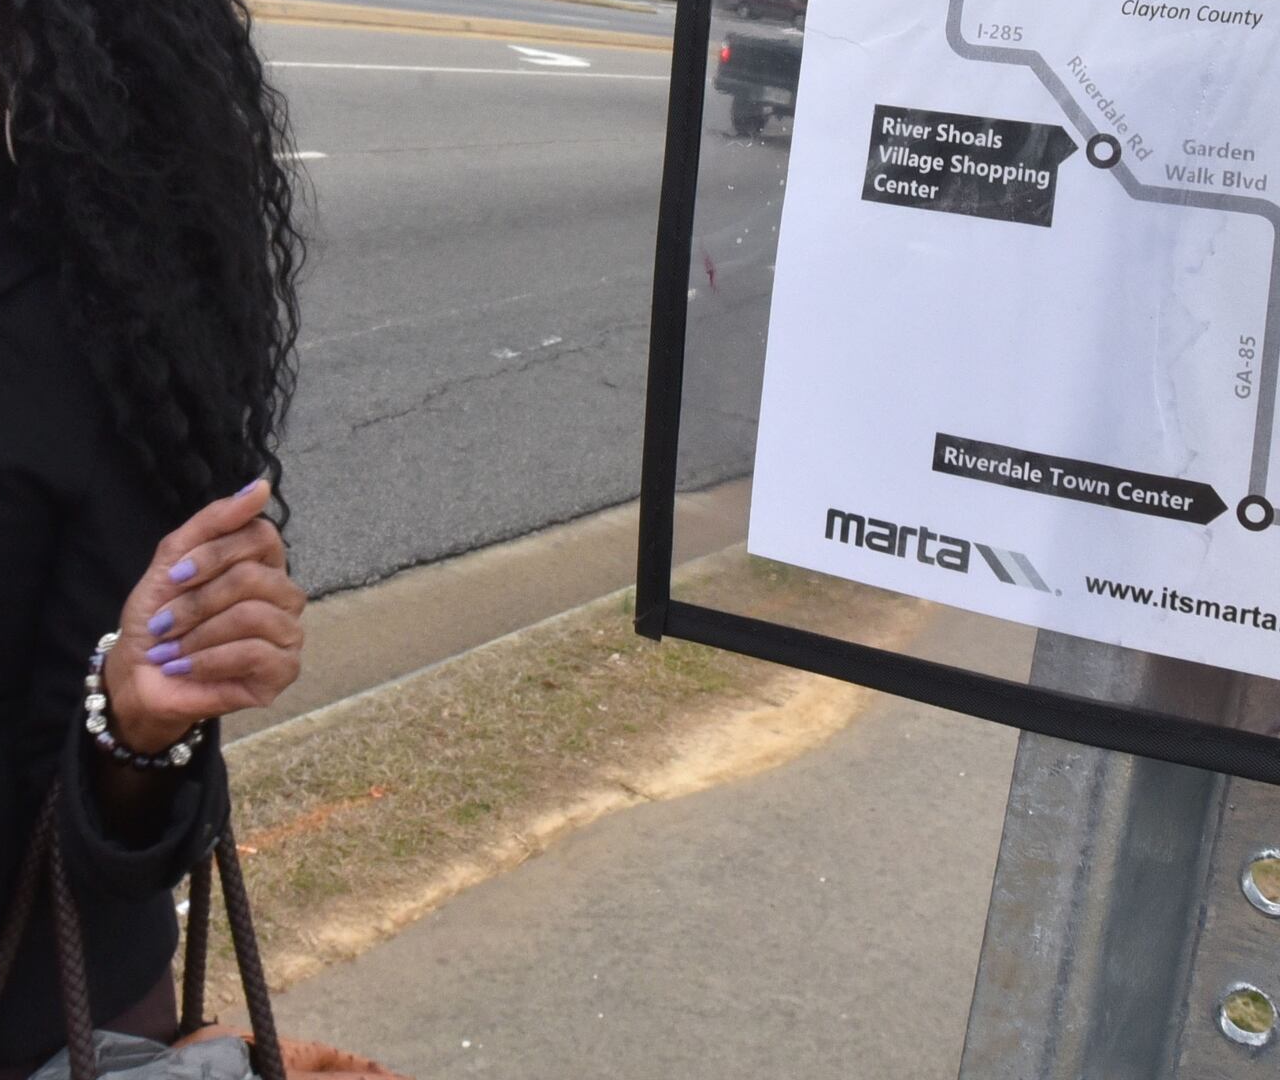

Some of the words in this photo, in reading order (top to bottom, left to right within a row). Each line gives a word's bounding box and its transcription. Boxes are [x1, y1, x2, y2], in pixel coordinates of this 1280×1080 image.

[1121, 0, 1191, 22] Clayton
[1197, 5, 1263, 29] County
[978, 24, 1023, 42] I-285
[1067, 55, 1129, 137] Riverdale
[1127, 133, 1154, 163] Rd
[882, 117, 932, 140] River
[936, 125, 1002, 149] Shoals
[1182, 139, 1255, 162] Garden
[879, 145, 945, 173] Village
[950, 154, 1050, 189] Shopping
[1165, 165, 1214, 186] Walk
[1222, 171, 1267, 192] Blvd
[874, 174, 938, 200] Center
[1234, 335, 1256, 399] GA-85
[943, 445, 1042, 483] Riverdale
[1049, 466, 1110, 497] Town
[1117, 481, 1194, 512] Center
[825, 507, 970, 573] marta
